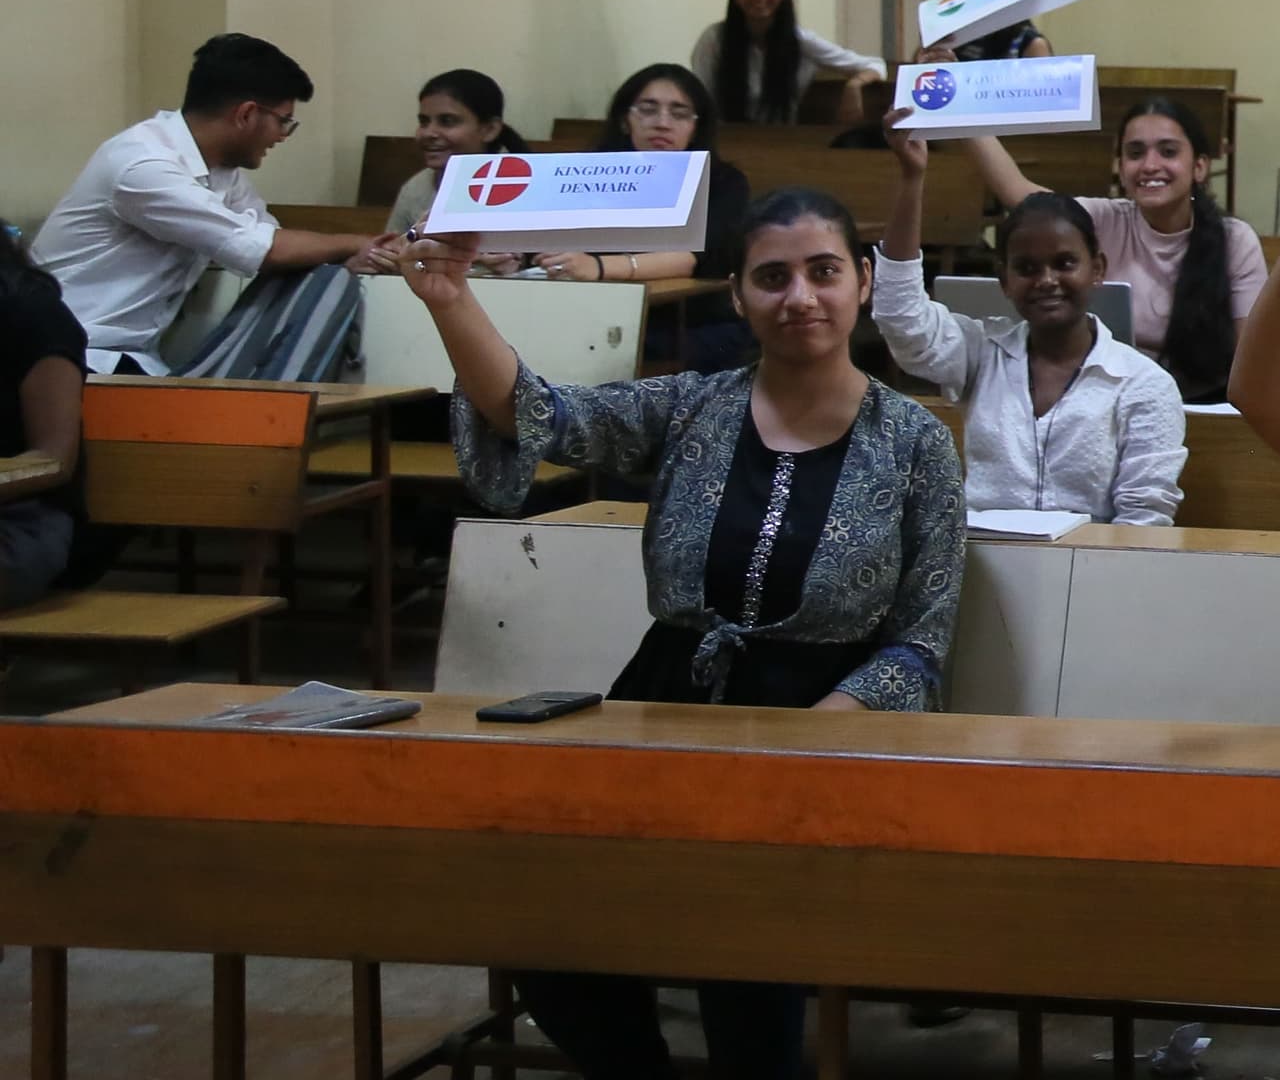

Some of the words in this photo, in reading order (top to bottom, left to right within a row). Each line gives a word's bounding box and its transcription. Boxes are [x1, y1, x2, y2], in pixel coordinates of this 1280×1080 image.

[974, 89, 991, 100] OF
[553, 164, 632, 177] KINGDOM
[634, 164, 657, 176] OF
[559, 181, 640, 194] DENMARK
